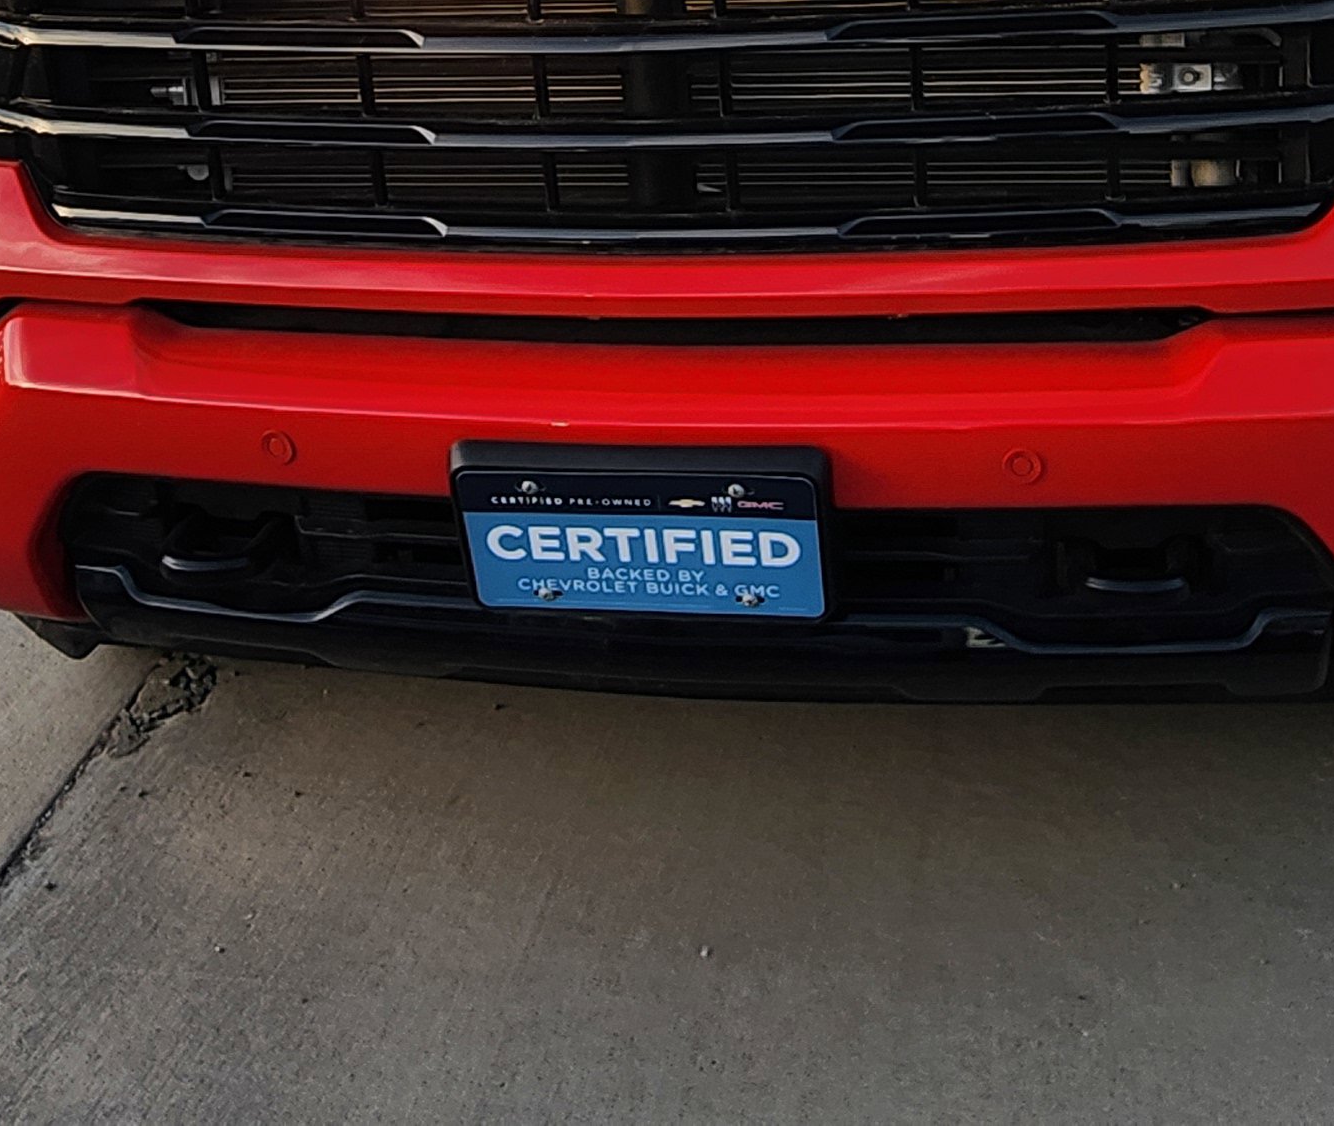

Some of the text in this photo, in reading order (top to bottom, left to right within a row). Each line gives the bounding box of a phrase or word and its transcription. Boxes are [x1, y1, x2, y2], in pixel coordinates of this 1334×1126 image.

[490, 496, 652, 507] CERTIFIED PRE-OWNED
[737, 500, 784, 511] GMC
[486, 525, 801, 567] CERTIFIED
[587, 567, 705, 583] BACKED BY
[517, 578, 781, 599] CHEVROLET BUICK & GMC
